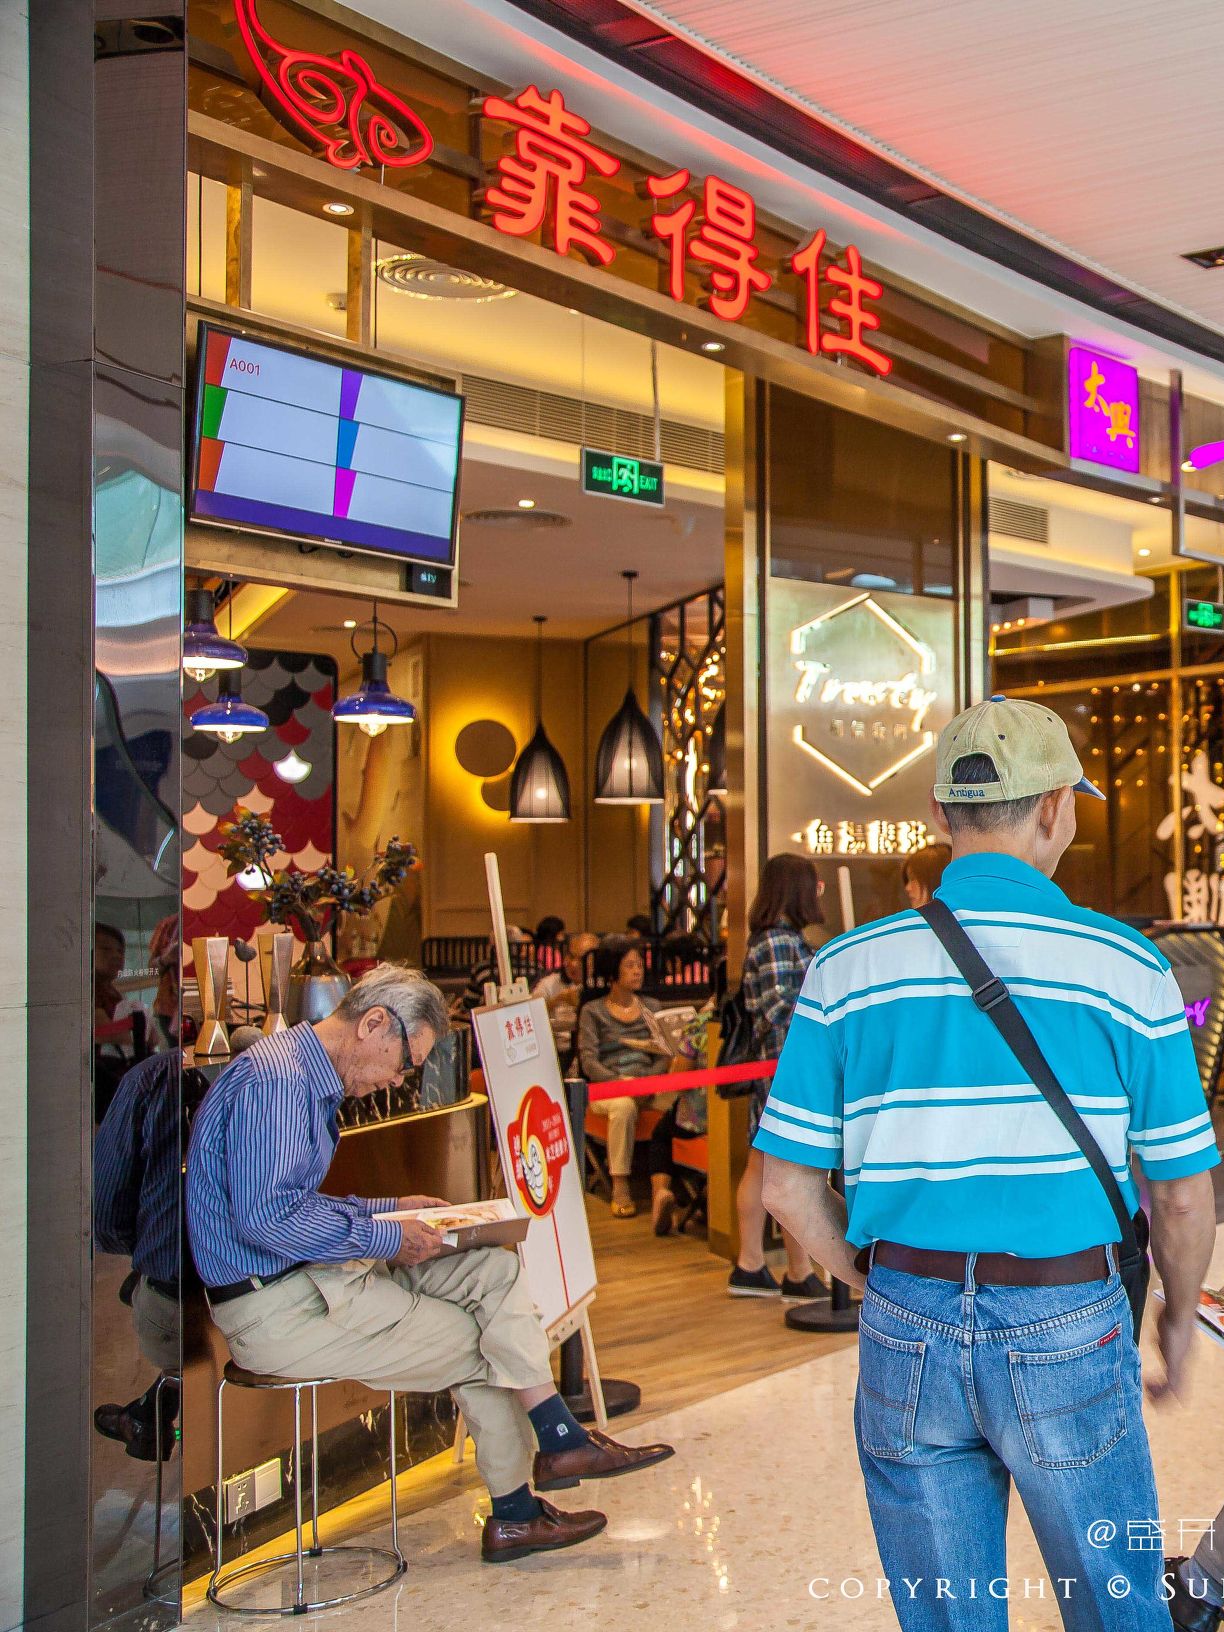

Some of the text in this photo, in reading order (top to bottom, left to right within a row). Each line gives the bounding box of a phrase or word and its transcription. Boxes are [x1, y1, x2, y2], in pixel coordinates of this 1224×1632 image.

[483, 85, 893, 376] 靠得住
[229, 358, 261, 376] A001
[640, 475, 658, 491] EXIT
[948, 786, 985, 799] Antigua
